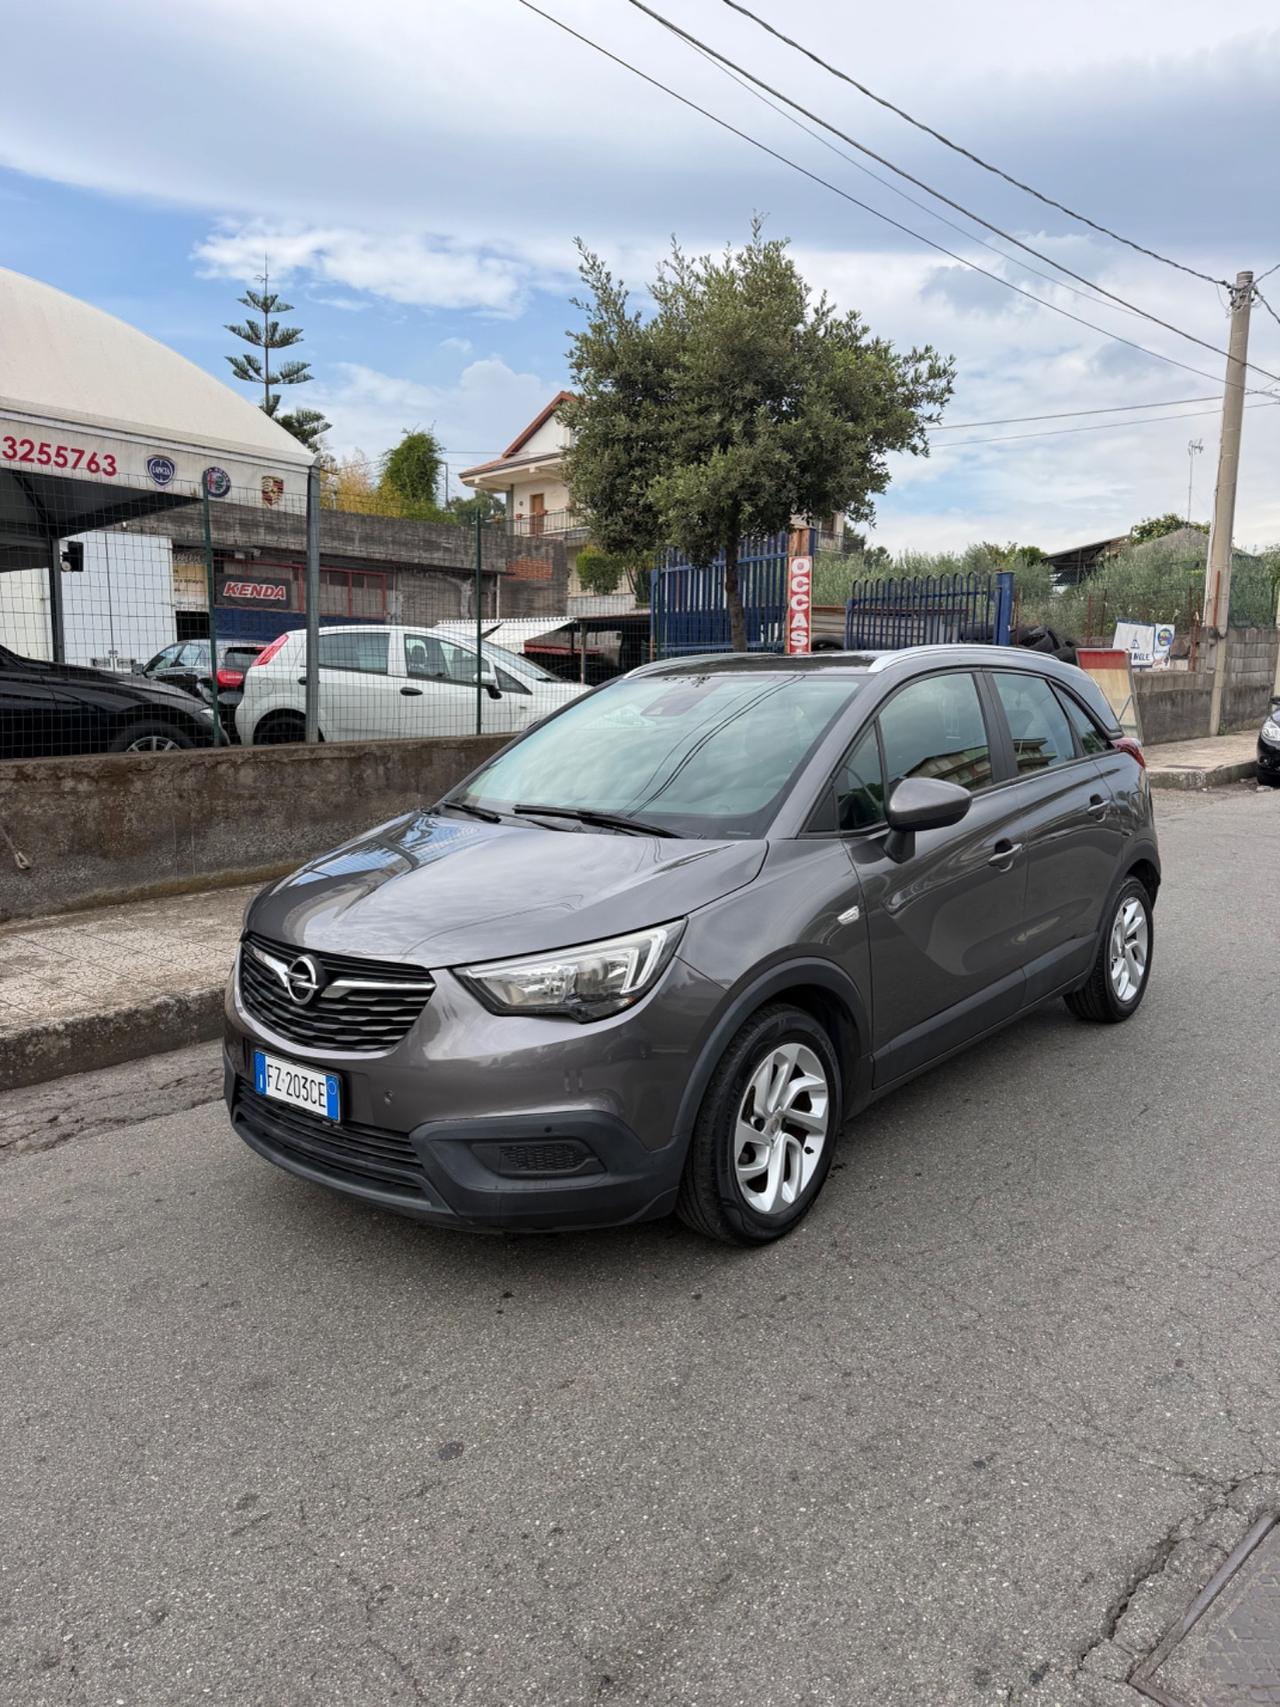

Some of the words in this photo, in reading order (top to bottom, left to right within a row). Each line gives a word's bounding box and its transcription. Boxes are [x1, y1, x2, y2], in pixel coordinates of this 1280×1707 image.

[2, 435, 117, 477] 3255763
[223, 581, 287, 600] KENDA
[790, 558, 810, 654] OCCAS
